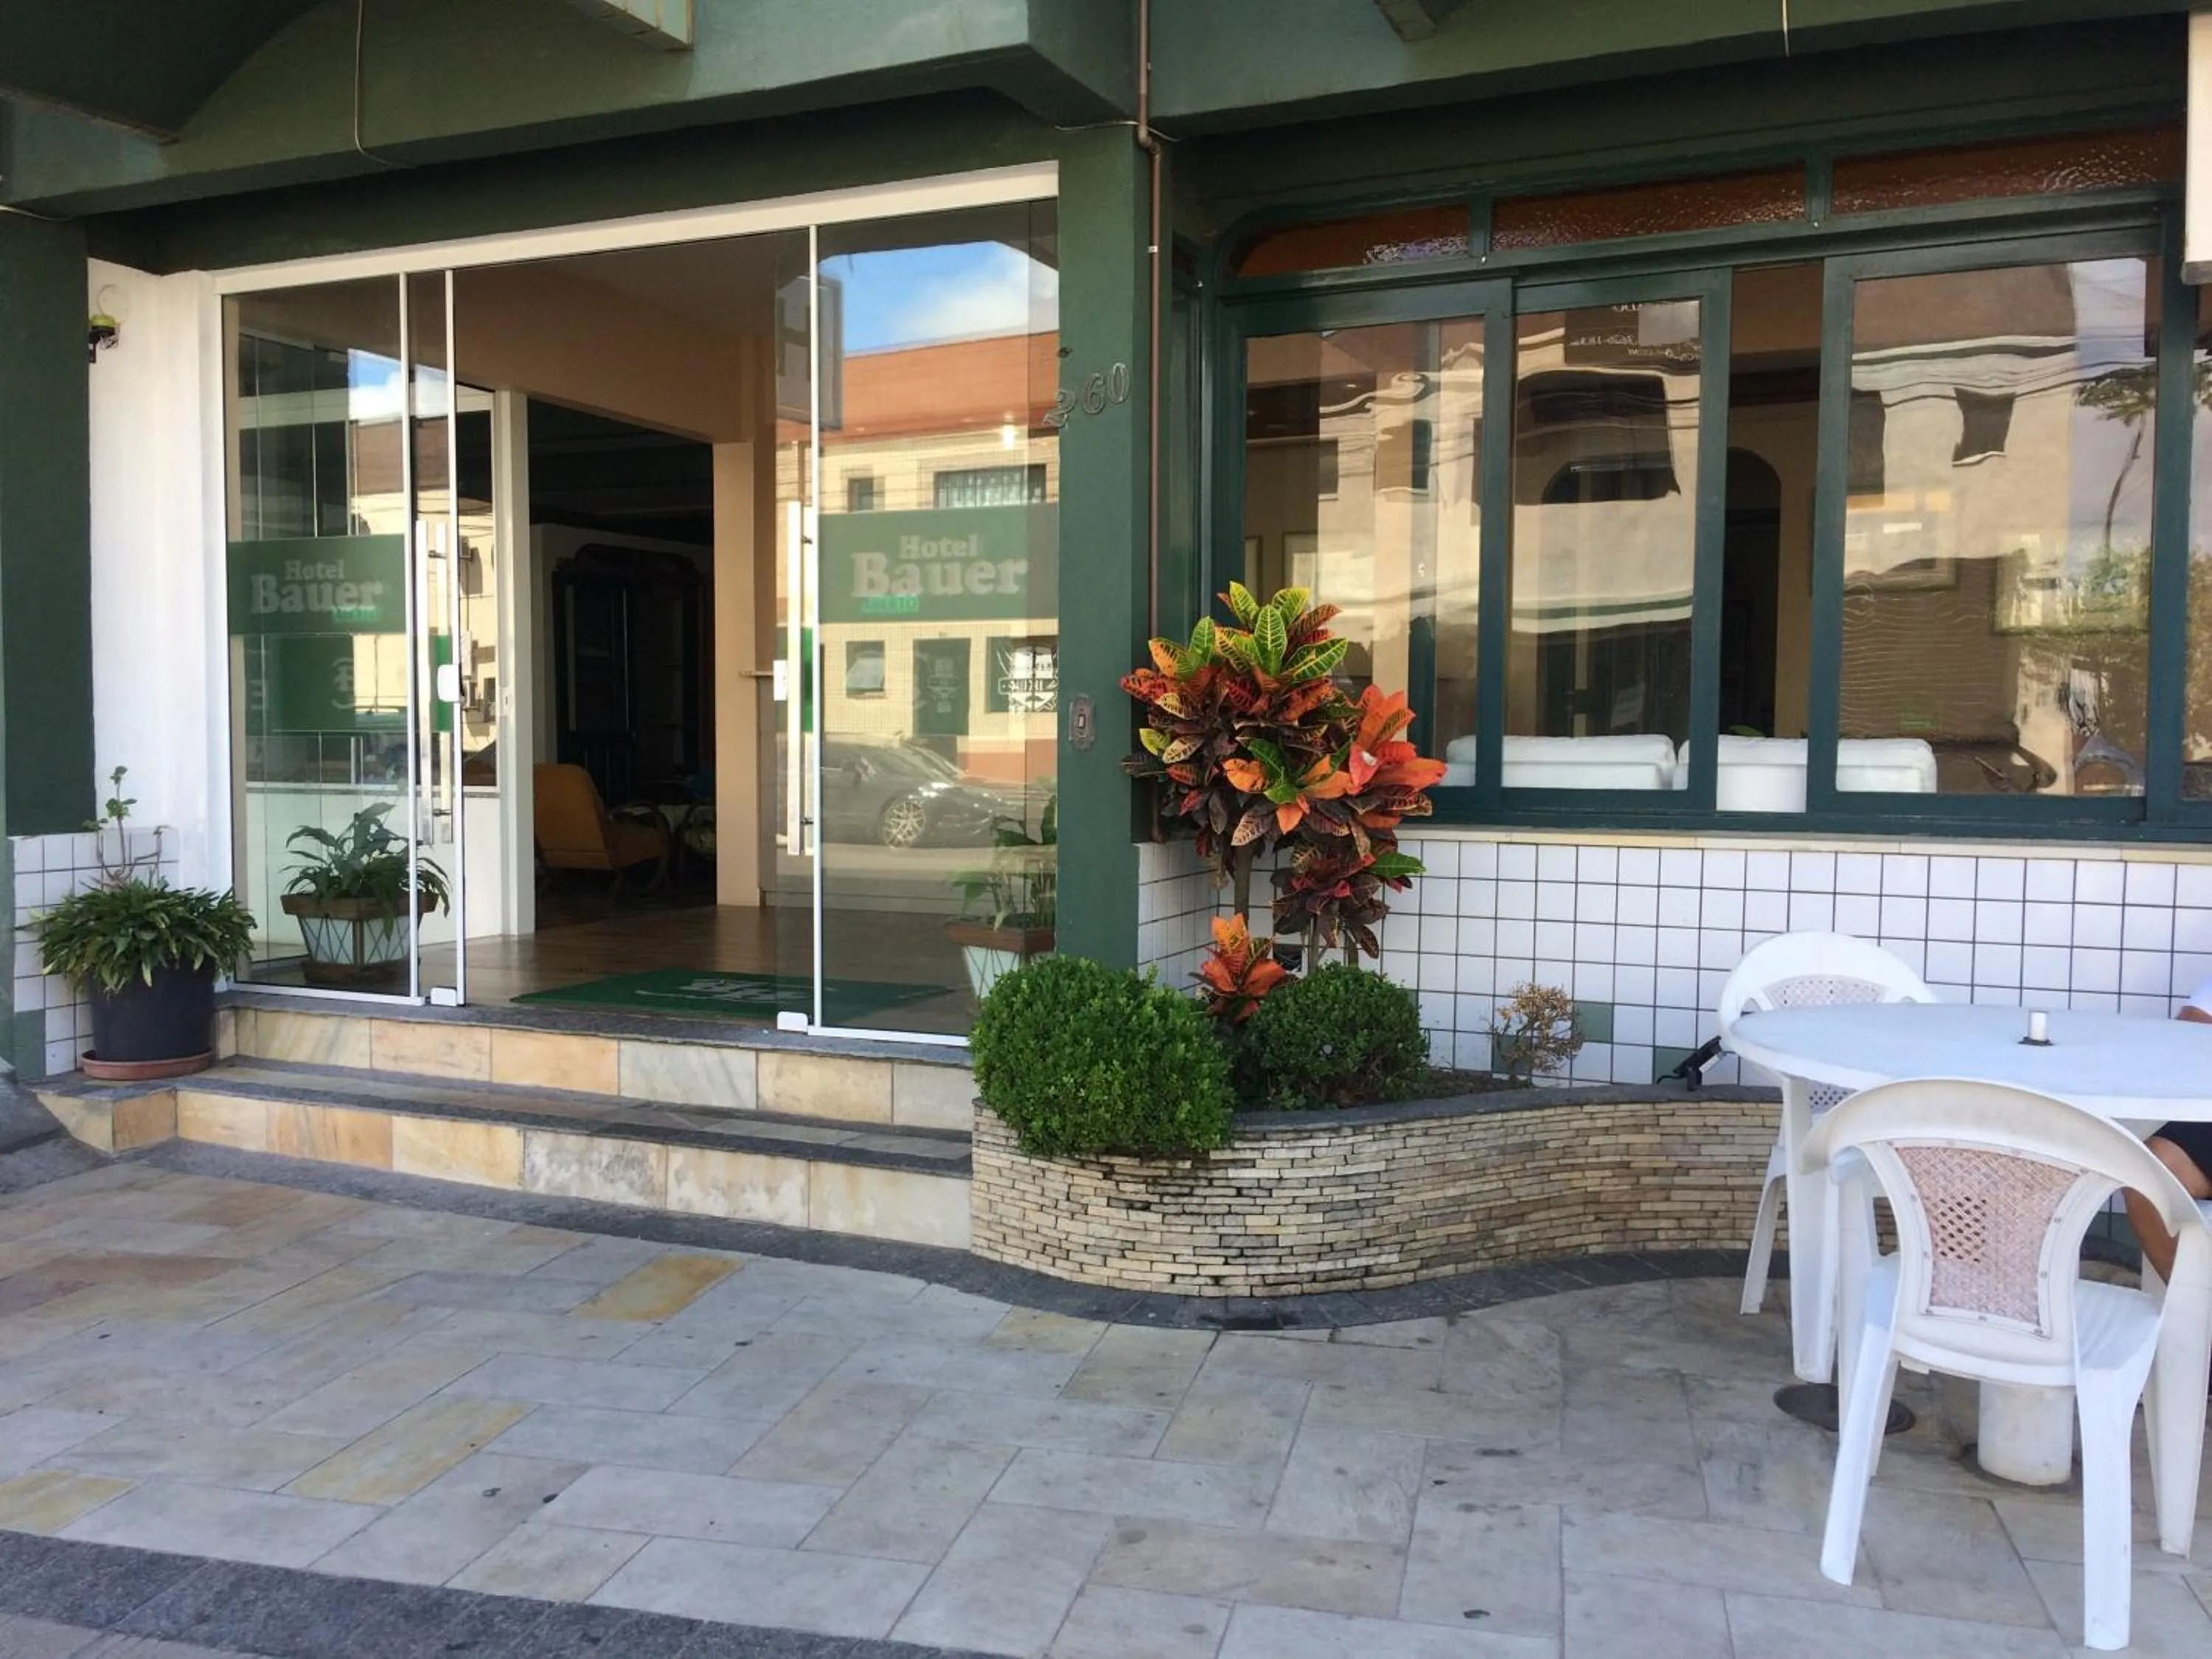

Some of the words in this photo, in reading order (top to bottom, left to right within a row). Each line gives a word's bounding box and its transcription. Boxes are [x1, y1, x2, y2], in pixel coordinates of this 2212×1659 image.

[1042, 363, 1130, 427] 260
[900, 533, 978, 559] Hotel
[285, 558, 344, 580] Hotel
[851, 552, 1027, 597] Bauer
[250, 573, 383, 613] Bauer
